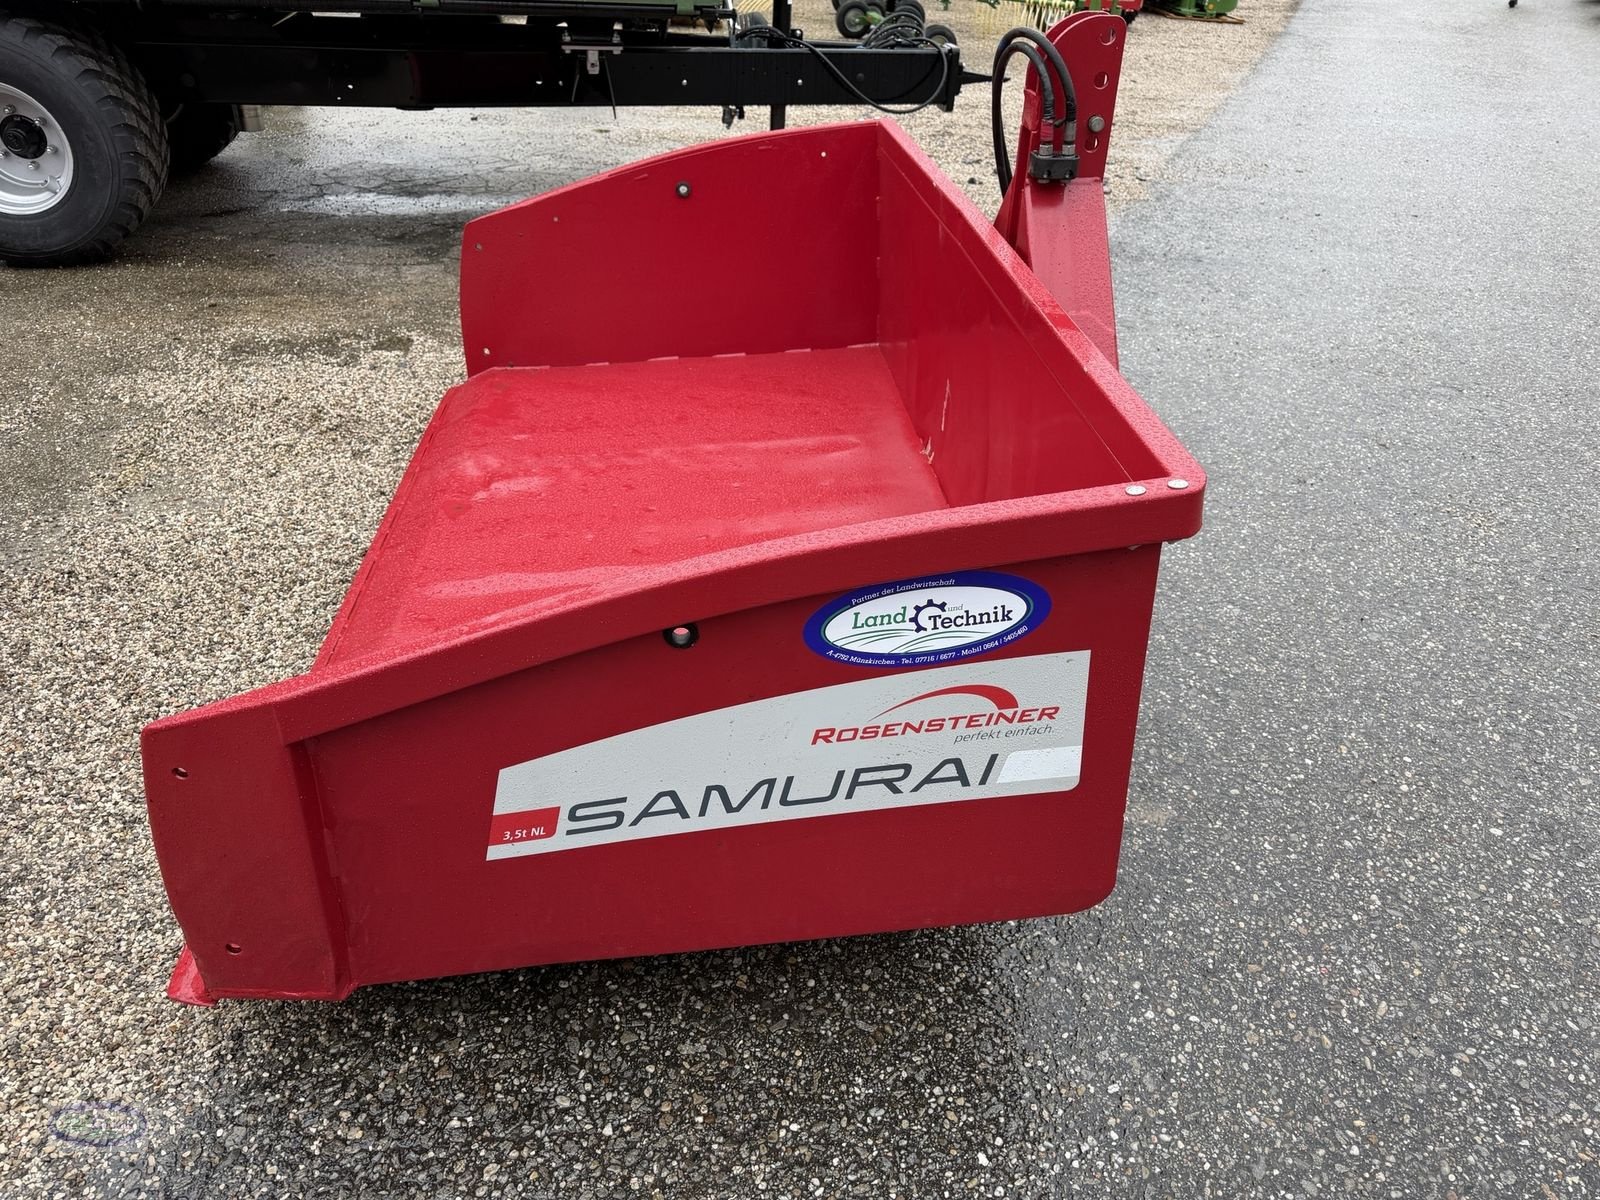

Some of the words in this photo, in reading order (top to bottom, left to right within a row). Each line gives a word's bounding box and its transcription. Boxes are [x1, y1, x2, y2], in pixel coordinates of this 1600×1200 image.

[851, 592, 880, 606] Partner
[881, 588, 894, 596] der
[896, 579, 956, 592] Landwirtschaft
[852, 606, 907, 630] Land
[928, 605, 1013, 631] Technik
[948, 603, 964, 612] und
[849, 656, 896, 665] Münzkirchen
[901, 657, 914, 665] Tel.
[940, 652, 956, 661] 6677
[961, 645, 982, 656] Mobil
[983, 640, 999, 650] 0664
[811, 705, 1060, 746] ROSENSTEINER
[953, 729, 1001, 745] perfekt
[565, 752, 999, 837] SAMURAI
[503, 829, 527, 841] 3,5t
[531, 827, 546, 837] NL
